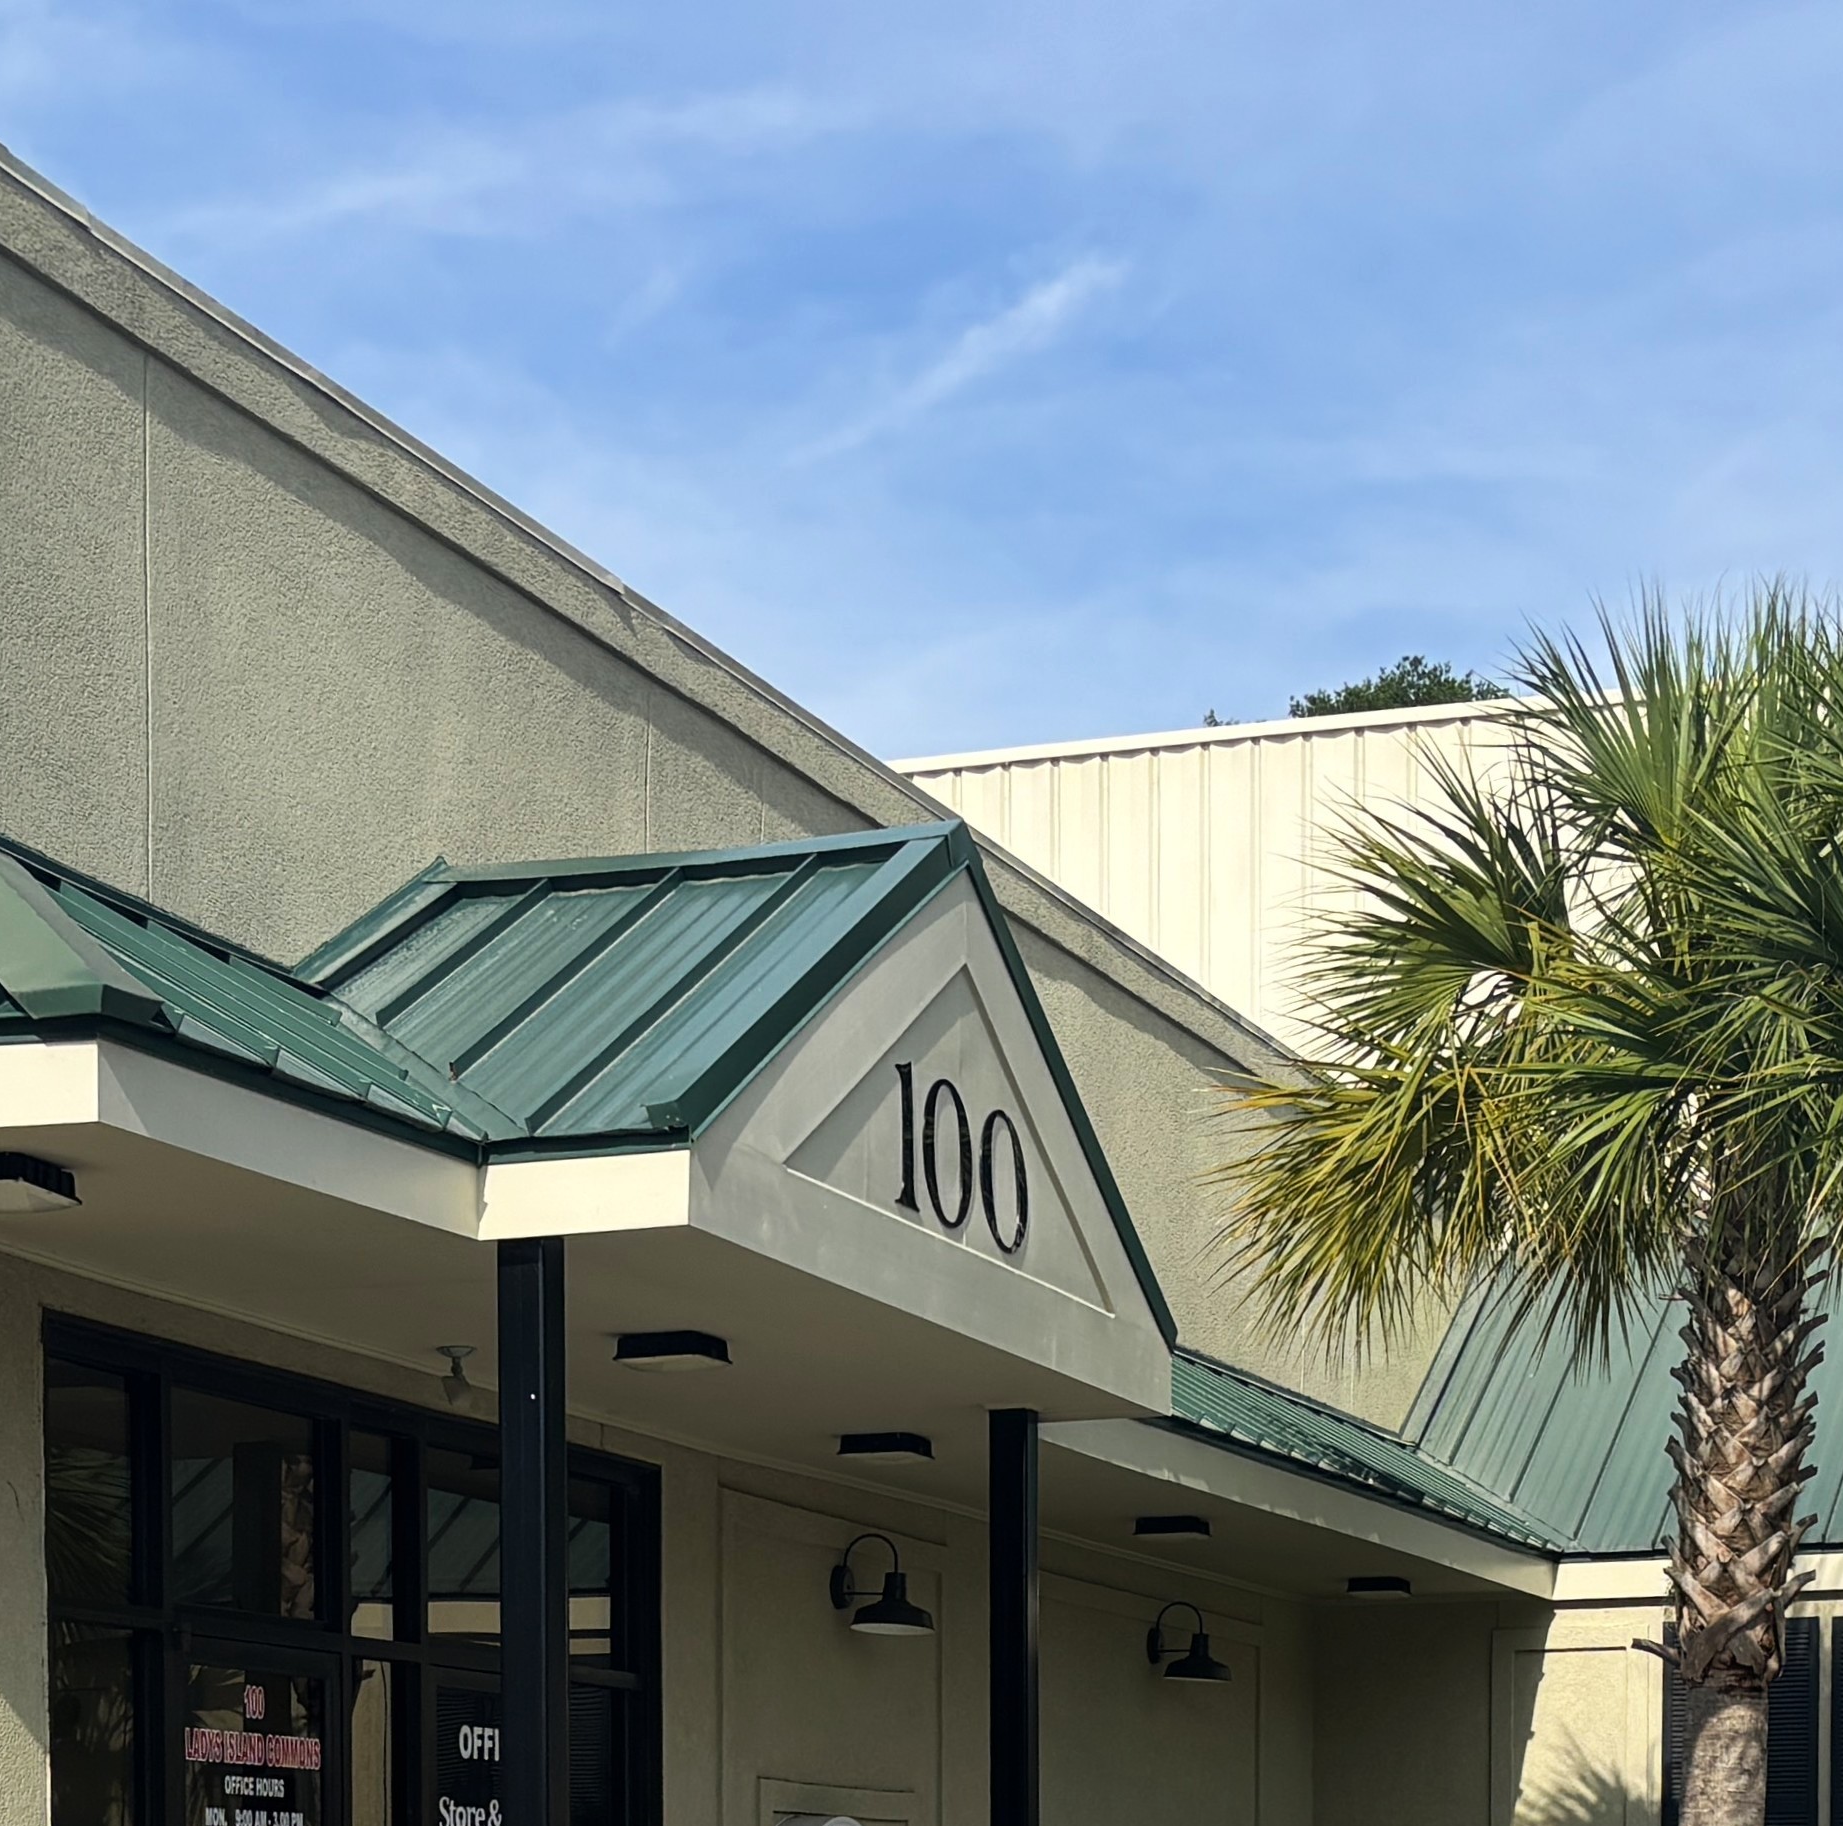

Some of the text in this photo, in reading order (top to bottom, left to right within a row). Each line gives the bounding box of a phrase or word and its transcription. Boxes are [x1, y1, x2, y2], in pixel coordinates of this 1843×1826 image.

[894, 1061, 1029, 1254] 100
[244, 1684, 265, 1719] 100
[185, 1727, 321, 1770] LADYS ISLAND COMMONS
[224, 1775, 284, 1798] OFFICE HOURS
[205, 1807, 227, 1826] MON.
